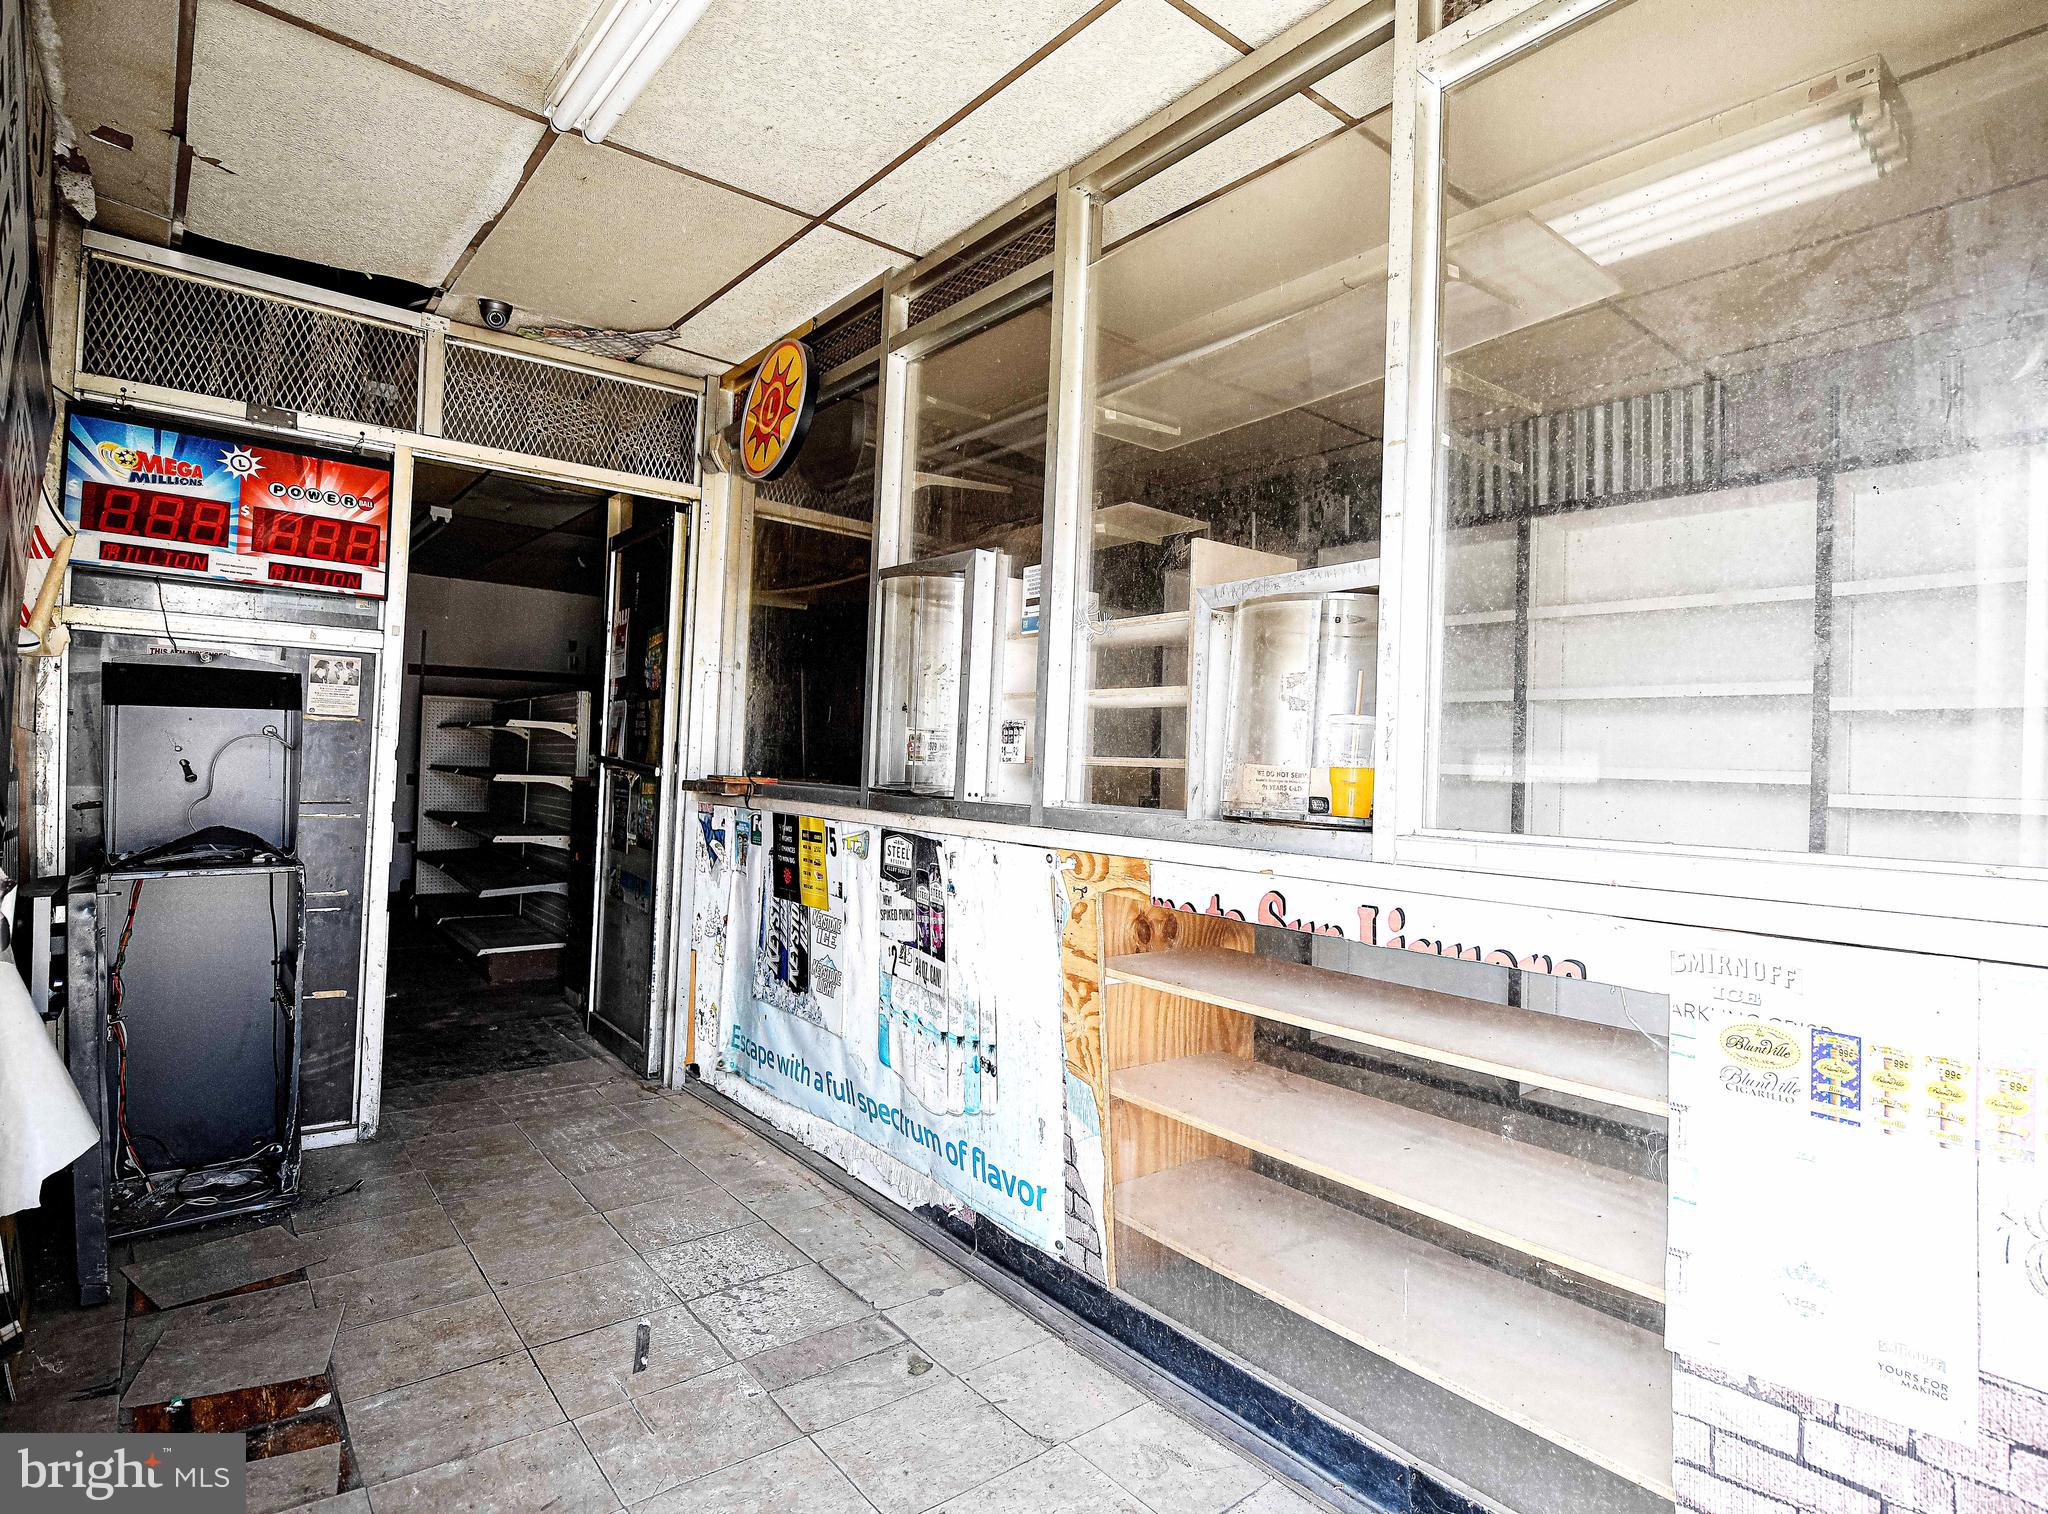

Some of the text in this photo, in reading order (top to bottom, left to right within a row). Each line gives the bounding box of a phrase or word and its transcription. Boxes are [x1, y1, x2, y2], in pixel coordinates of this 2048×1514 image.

[134, 450, 203, 480] MEGA
[128, 471, 204, 487] MILLIONS
[887, 844, 911, 861] STEEL
[880, 908, 915, 921] SPIKED PUNCH
[766, 896, 781, 976] KEYST
[816, 928, 838, 950] ICE
[1672, 951, 1798, 990] SMIRNOFF
[816, 977, 837, 999] LIGHT
[1725, 1034, 1792, 1059] BluntVille
[1719, 1064, 1802, 1096] BluntVille
[731, 1024, 775, 1070] Escape
[777, 1053, 811, 1087] with
[813, 1071, 824, 1093] a
[825, 1071, 856, 1107] full
[857, 1092, 943, 1157] spectrum
[945, 1139, 968, 1171] of
[972, 1146, 1047, 1212] flavor
[1877, 1361, 1949, 1393] YOURS FOR
[1900, 1380, 1949, 1402] MAKING
